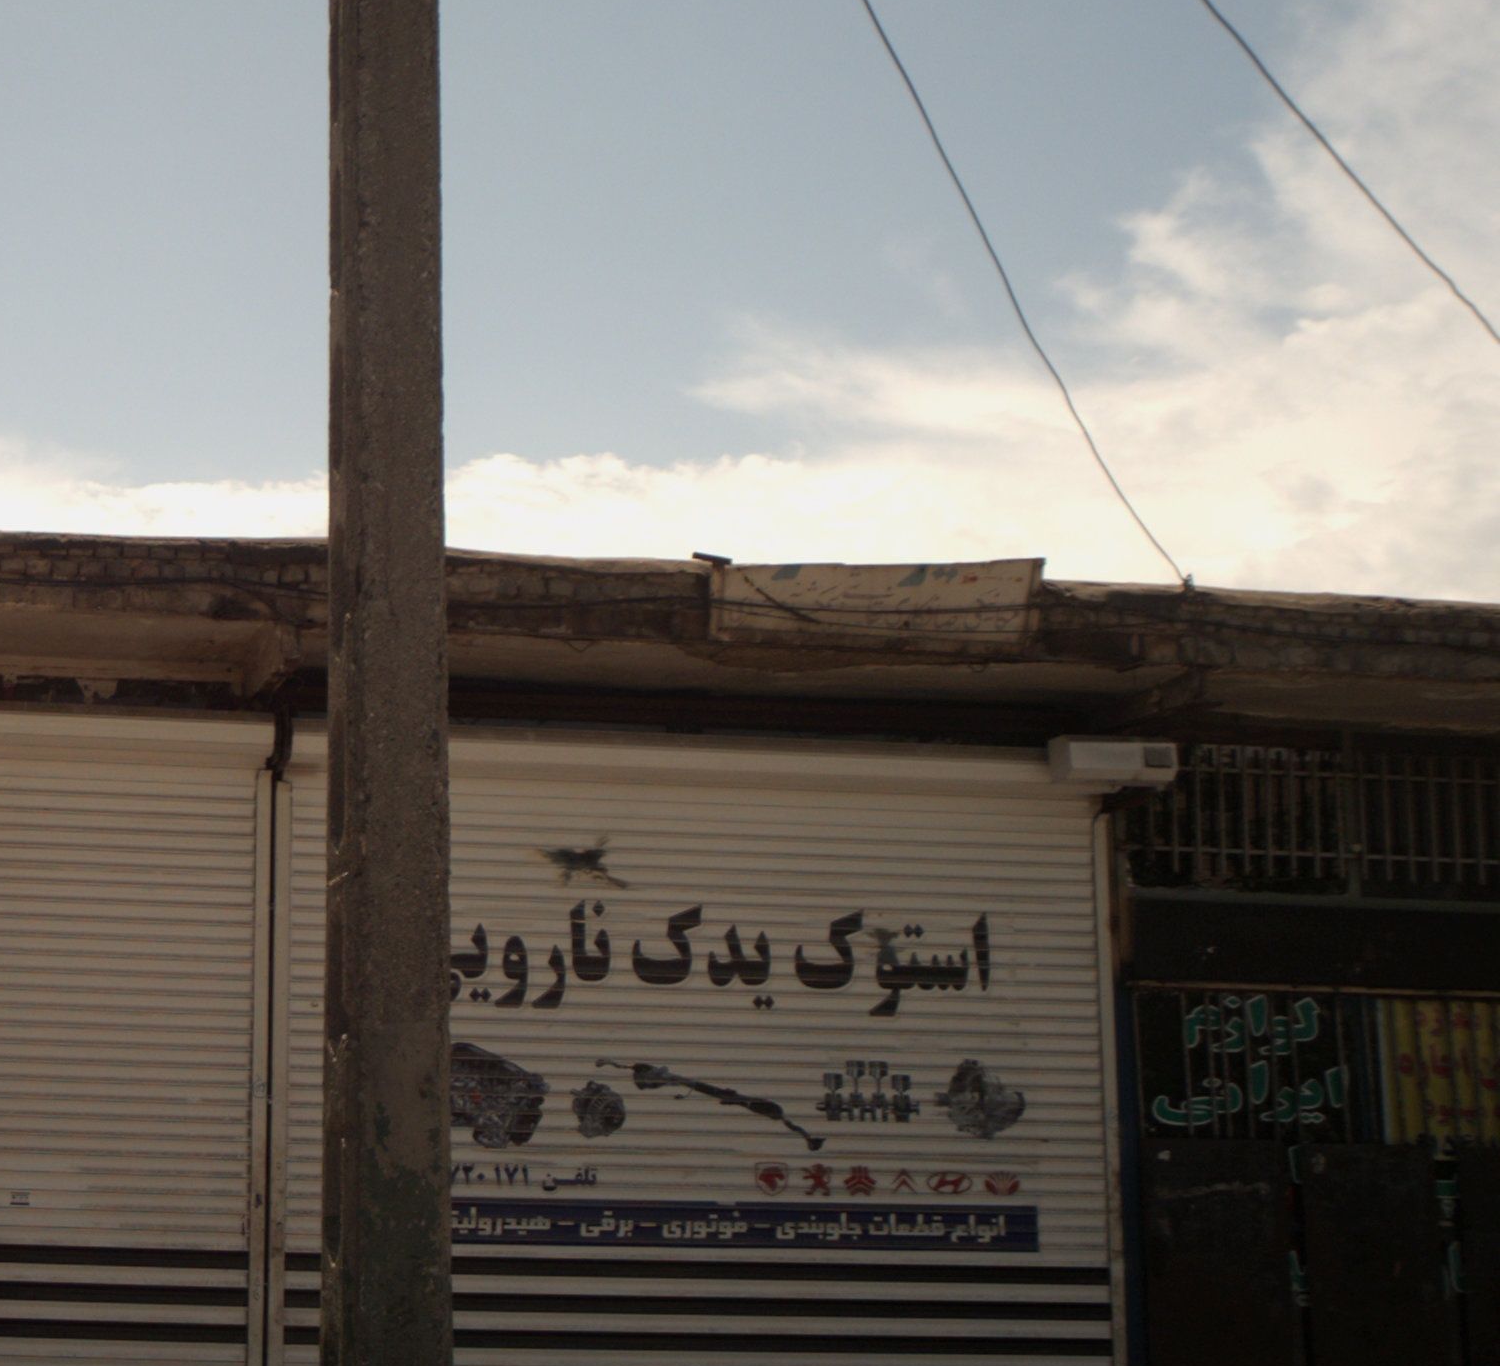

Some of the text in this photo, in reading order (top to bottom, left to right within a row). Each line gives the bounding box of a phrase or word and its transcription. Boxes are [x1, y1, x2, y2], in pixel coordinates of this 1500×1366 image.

[450, 899, 990, 1017] استوک یدک ناروی
[542, 1165, 598, 1192] تلفن
[451, 1206, 552, 1236] هیدرولی
[580, 1209, 634, 1238] برقی
[775, 1211, 863, 1241] جلوبندی
[867, 1212, 948, 1237] قطعات
[949, 1212, 1007, 1244] انواع
